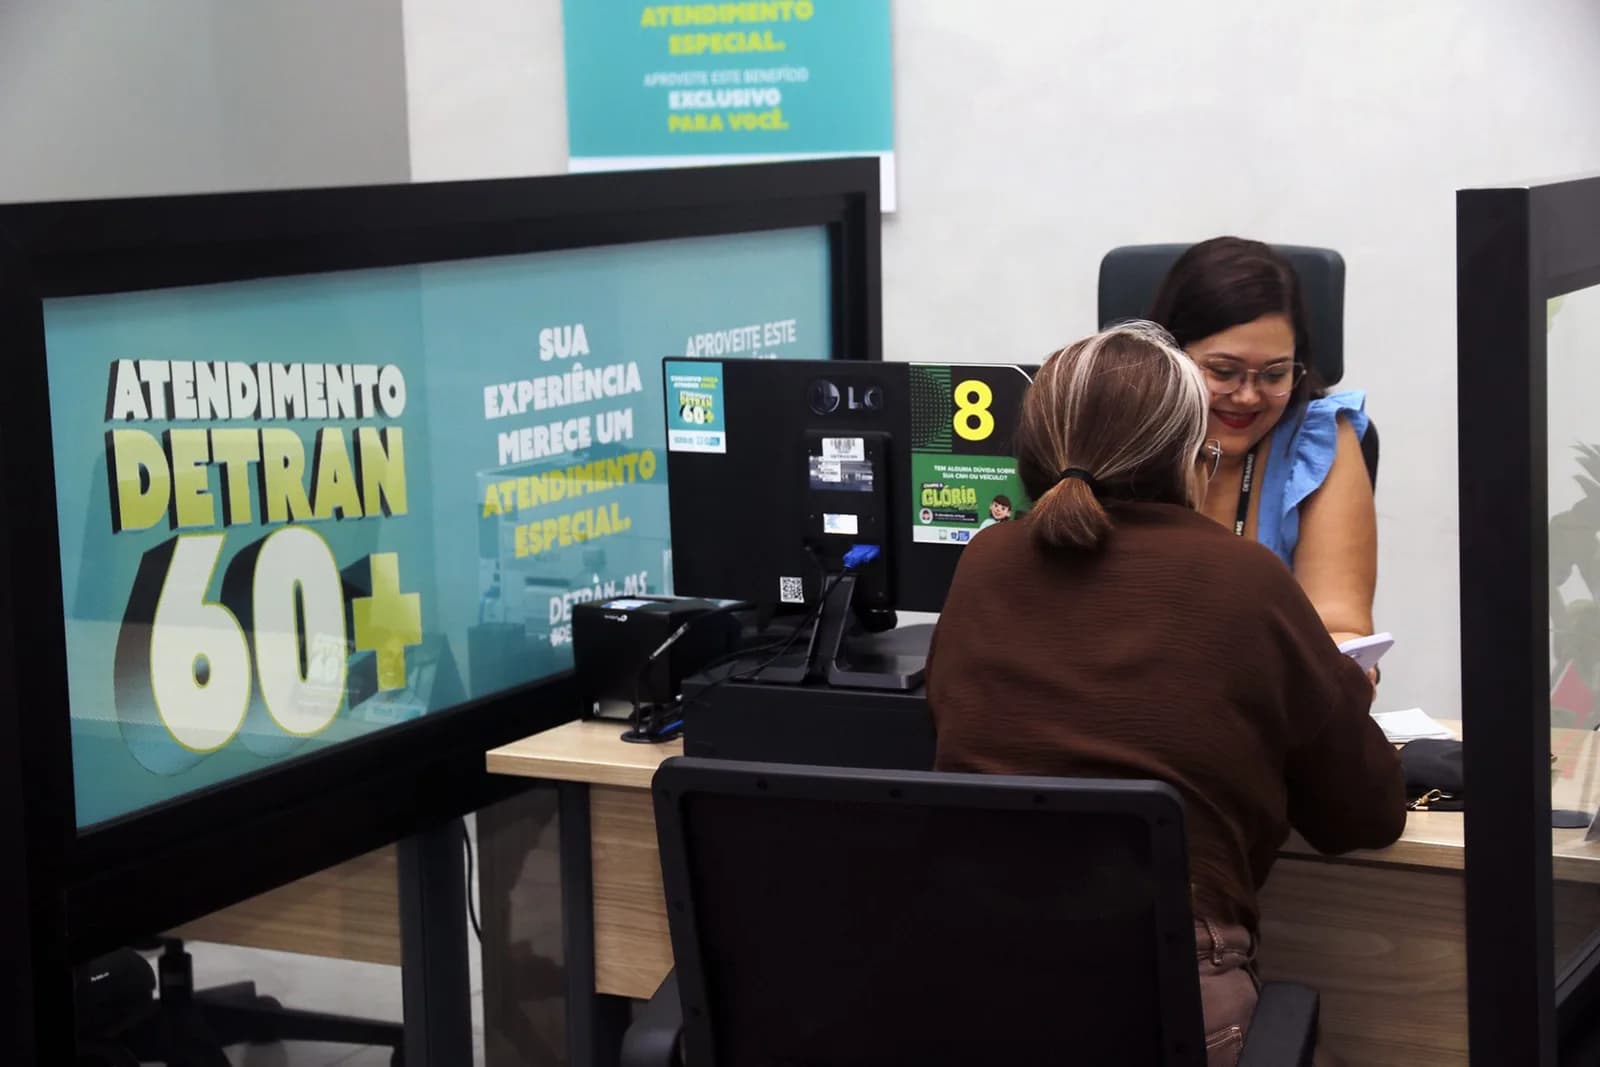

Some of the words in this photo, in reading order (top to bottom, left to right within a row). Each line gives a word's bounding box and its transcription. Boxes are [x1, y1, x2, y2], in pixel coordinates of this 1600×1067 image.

[640, 0, 814, 27] ATENDIMENTO
[669, 31, 786, 55] ESPECIAL.
[668, 87, 781, 110] EXCLUSIVO
[668, 113, 724, 133] PARA
[539, 323, 590, 361] SUA
[686, 325, 761, 358] APROVEITE
[763, 319, 796, 347] ESTE
[107, 360, 407, 421] ATENDIMENTO
[484, 361, 643, 420] EXPERIÊNCIA
[953, 380, 994, 441] 8
[498, 416, 592, 466] MERECE
[596, 408, 634, 444] UM
[106, 426, 408, 533] DETRAN
[482, 450, 657, 519] ATENDIMENTO
[947, 465, 972, 473] ALGUMA
[997, 467, 1016, 475] SOBRE
[515, 502, 632, 559] ESPECIAL.
[142, 524, 422, 756] 60+
